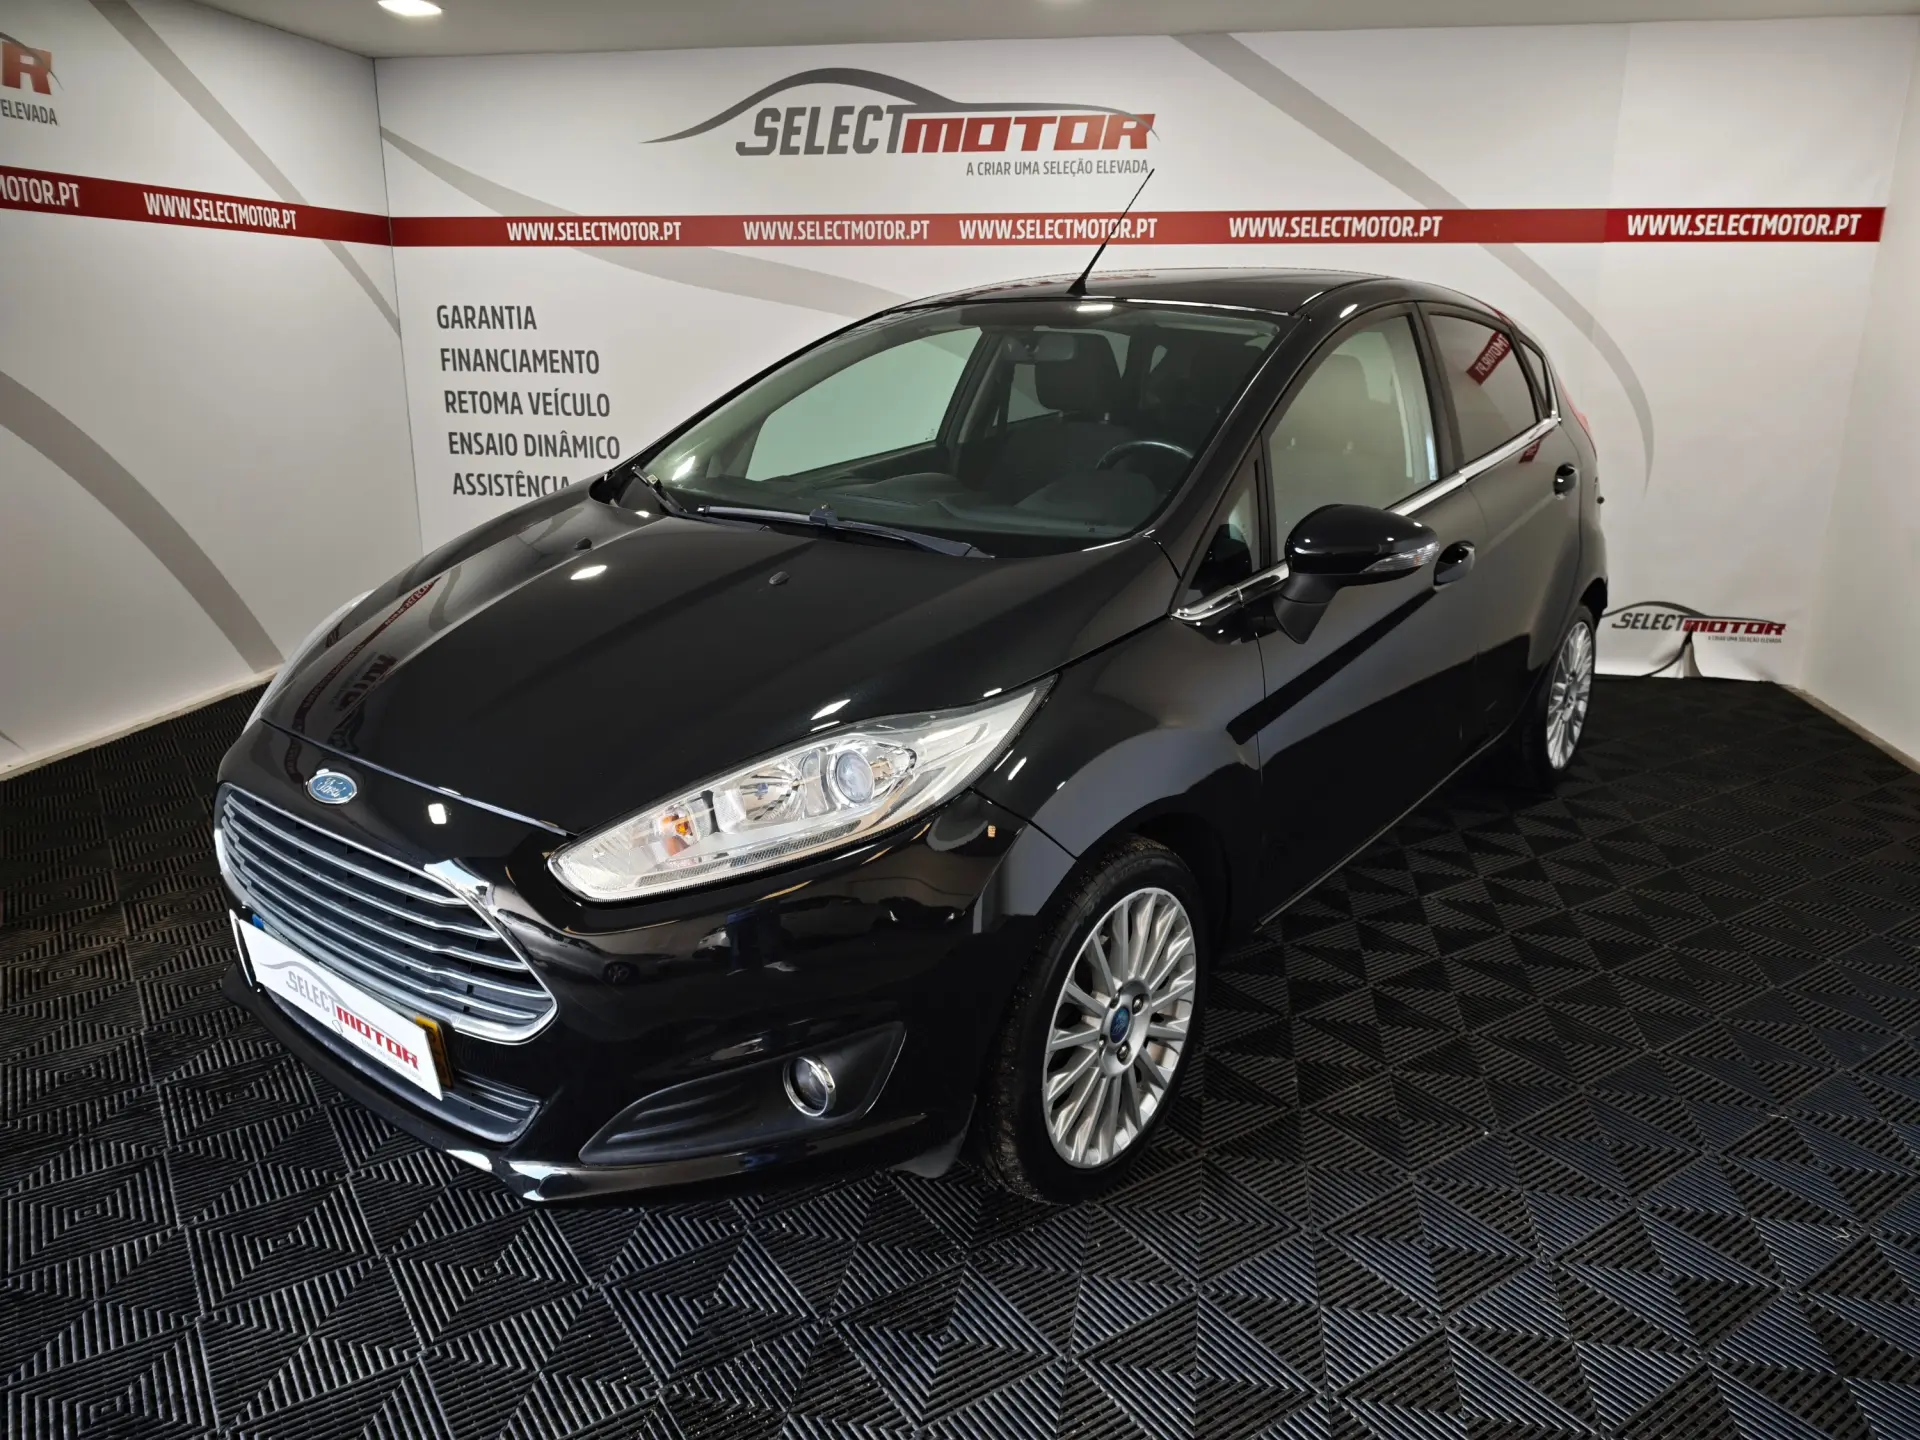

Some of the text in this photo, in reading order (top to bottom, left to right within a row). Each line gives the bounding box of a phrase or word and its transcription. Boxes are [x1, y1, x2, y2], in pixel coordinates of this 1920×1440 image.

[1, 100, 58, 126] ELEVADA
[966, 158, 1149, 177] A CRIAR UMA SELEÇÃO ELEVADA
[143, 192, 297, 230] WWW.SELECTMOTOR.PT
[507, 221, 681, 241] WWW.SELECTMOTOR.PT
[743, 220, 930, 240] WWW.SELECTMOTOR.PT
[959, 218, 1157, 240] WWW.SELECTMOTOR.PT
[1229, 216, 1443, 238] WWW.SELECTMOTOR.PT
[1627, 214, 1862, 236] WWW.SELECTMOTOR.PT
[436, 304, 537, 330] GARANTIA
[440, 348, 600, 374] FINANCIAMENTO
[444, 388, 610, 417] RETOMA VEÍCULO
[448, 430, 620, 459] ENSAIO DINÂMICO
[315, 776, 347, 798] Ford
